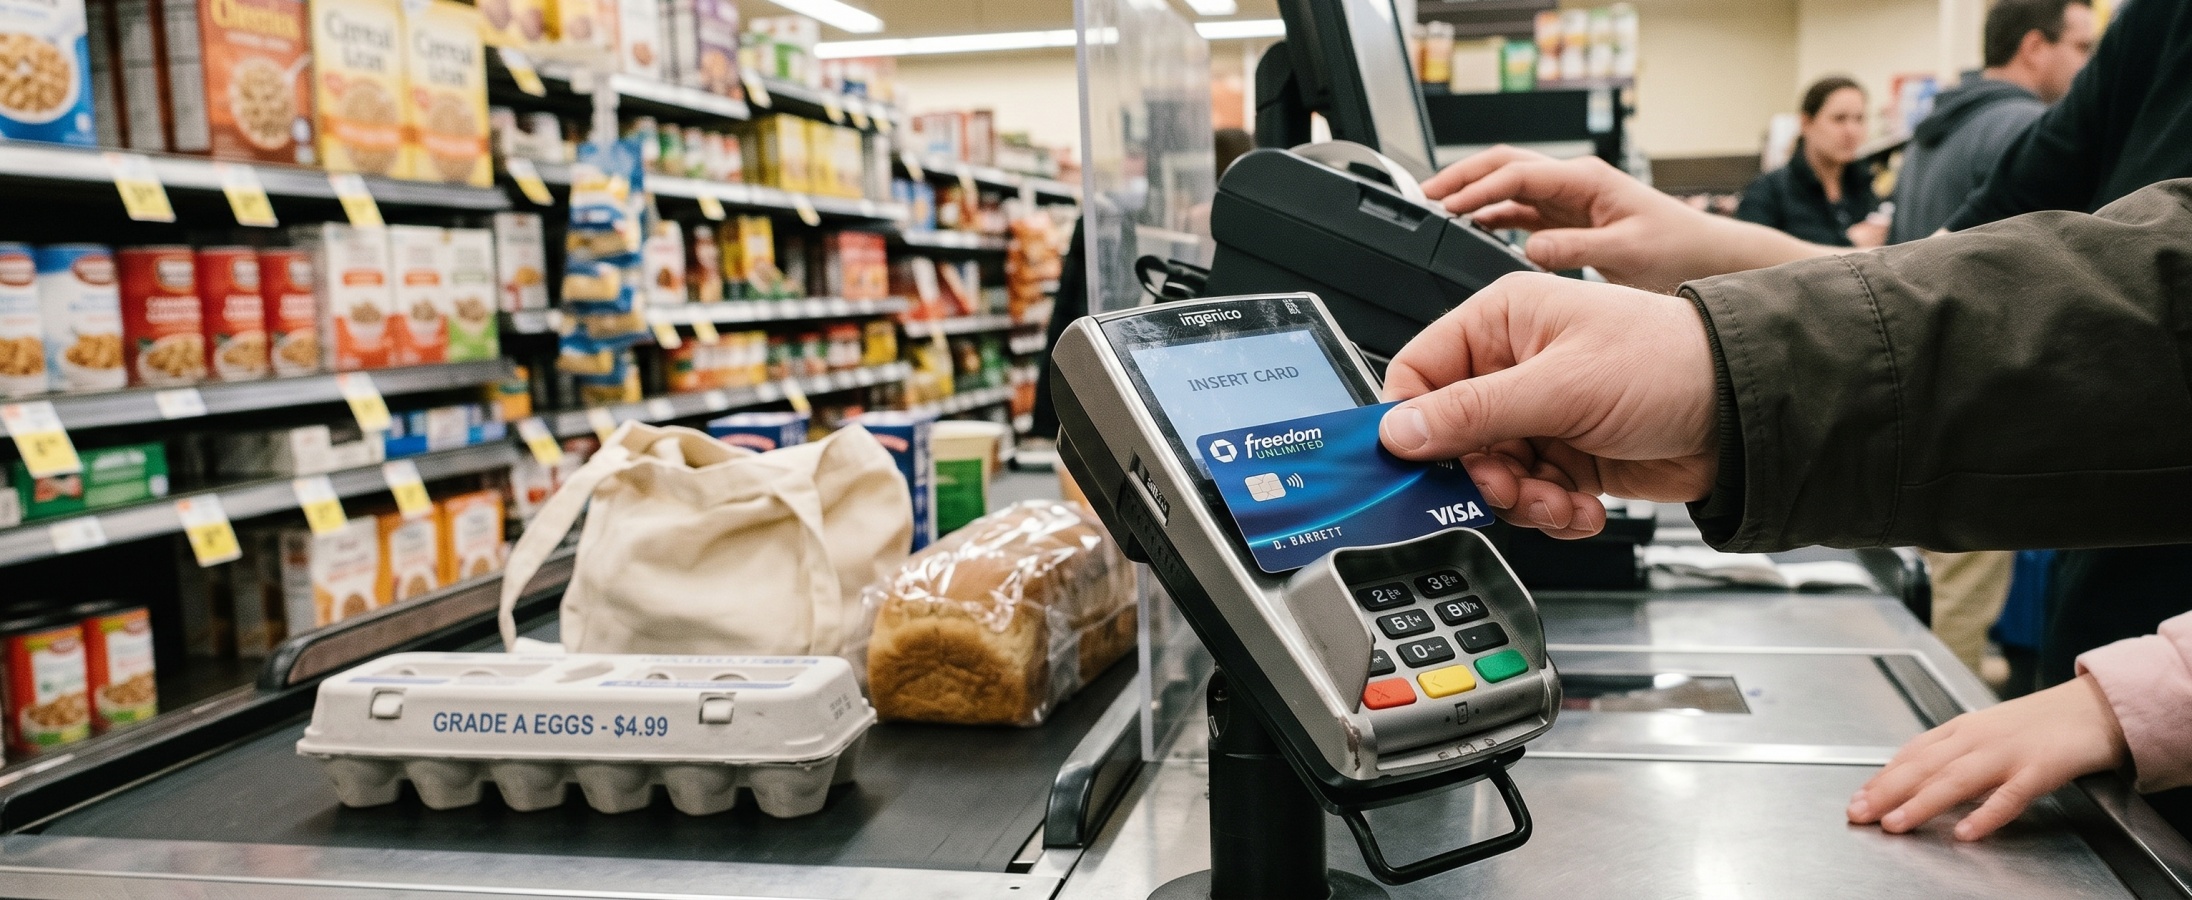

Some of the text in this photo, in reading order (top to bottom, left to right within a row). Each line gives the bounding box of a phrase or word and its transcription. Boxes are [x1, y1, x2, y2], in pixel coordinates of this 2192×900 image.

[1178, 308, 1242, 327] ingenico
[1187, 366, 1299, 392] INSERT CARD
[1244, 427, 1322, 459] freedom
[1255, 440, 1324, 459] UNLIMITED
[1425, 500, 1485, 526] VISA
[1272, 526, 1342, 550] D. BARRETT
[1427, 576, 1443, 590] 3
[1371, 589, 1389, 603] 2
[1411, 644, 1429, 659] 0
[433, 711, 507, 733] GRADE
[512, 713, 528, 734] A
[533, 713, 594, 735] EGGS
[613, 714, 668, 738] $4.99
